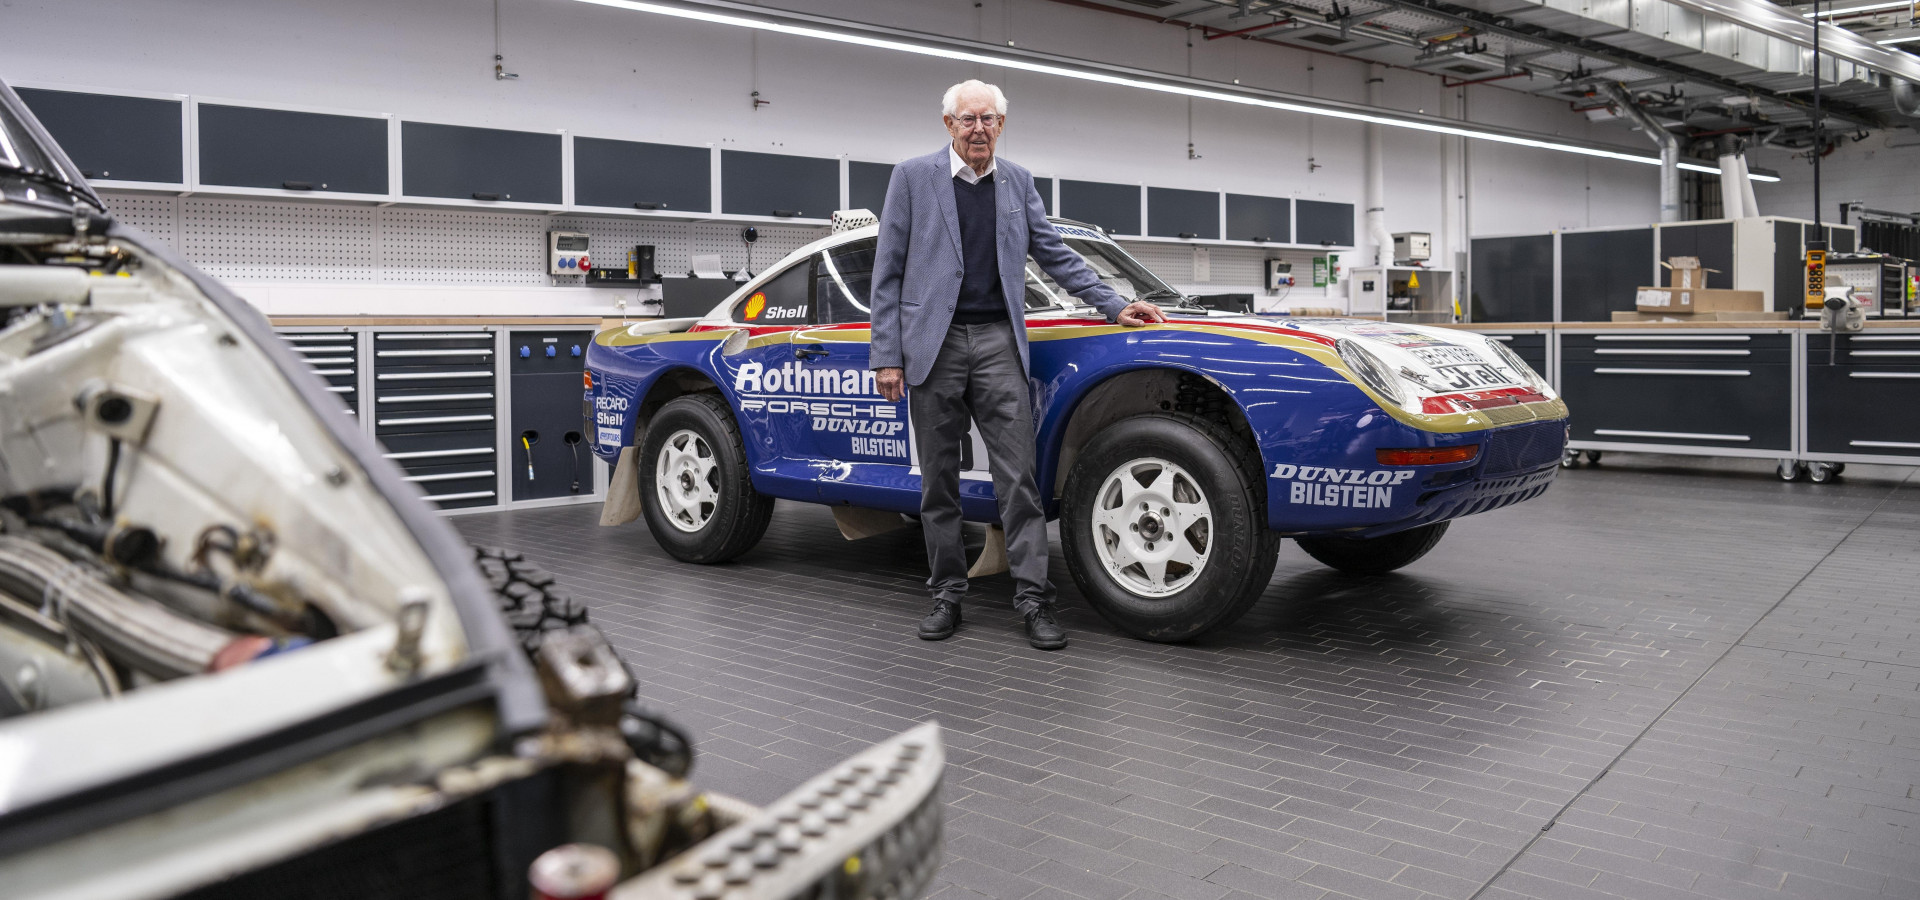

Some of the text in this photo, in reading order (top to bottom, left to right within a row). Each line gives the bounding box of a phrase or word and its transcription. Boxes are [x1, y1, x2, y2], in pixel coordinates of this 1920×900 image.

[765, 305, 807, 319] Shell
[734, 361, 880, 395] Rothman
[1435, 364, 1513, 389] Shell
[596, 396, 628, 411] RECARO
[740, 399, 897, 418] PORSCHE
[597, 412, 623, 425] Shell
[812, 416, 904, 436] DUNLOP
[851, 436, 907, 458] BILSTEIN
[1269, 463, 1416, 486] DUNLOP
[1290, 481, 1393, 508] BILSTEIN
